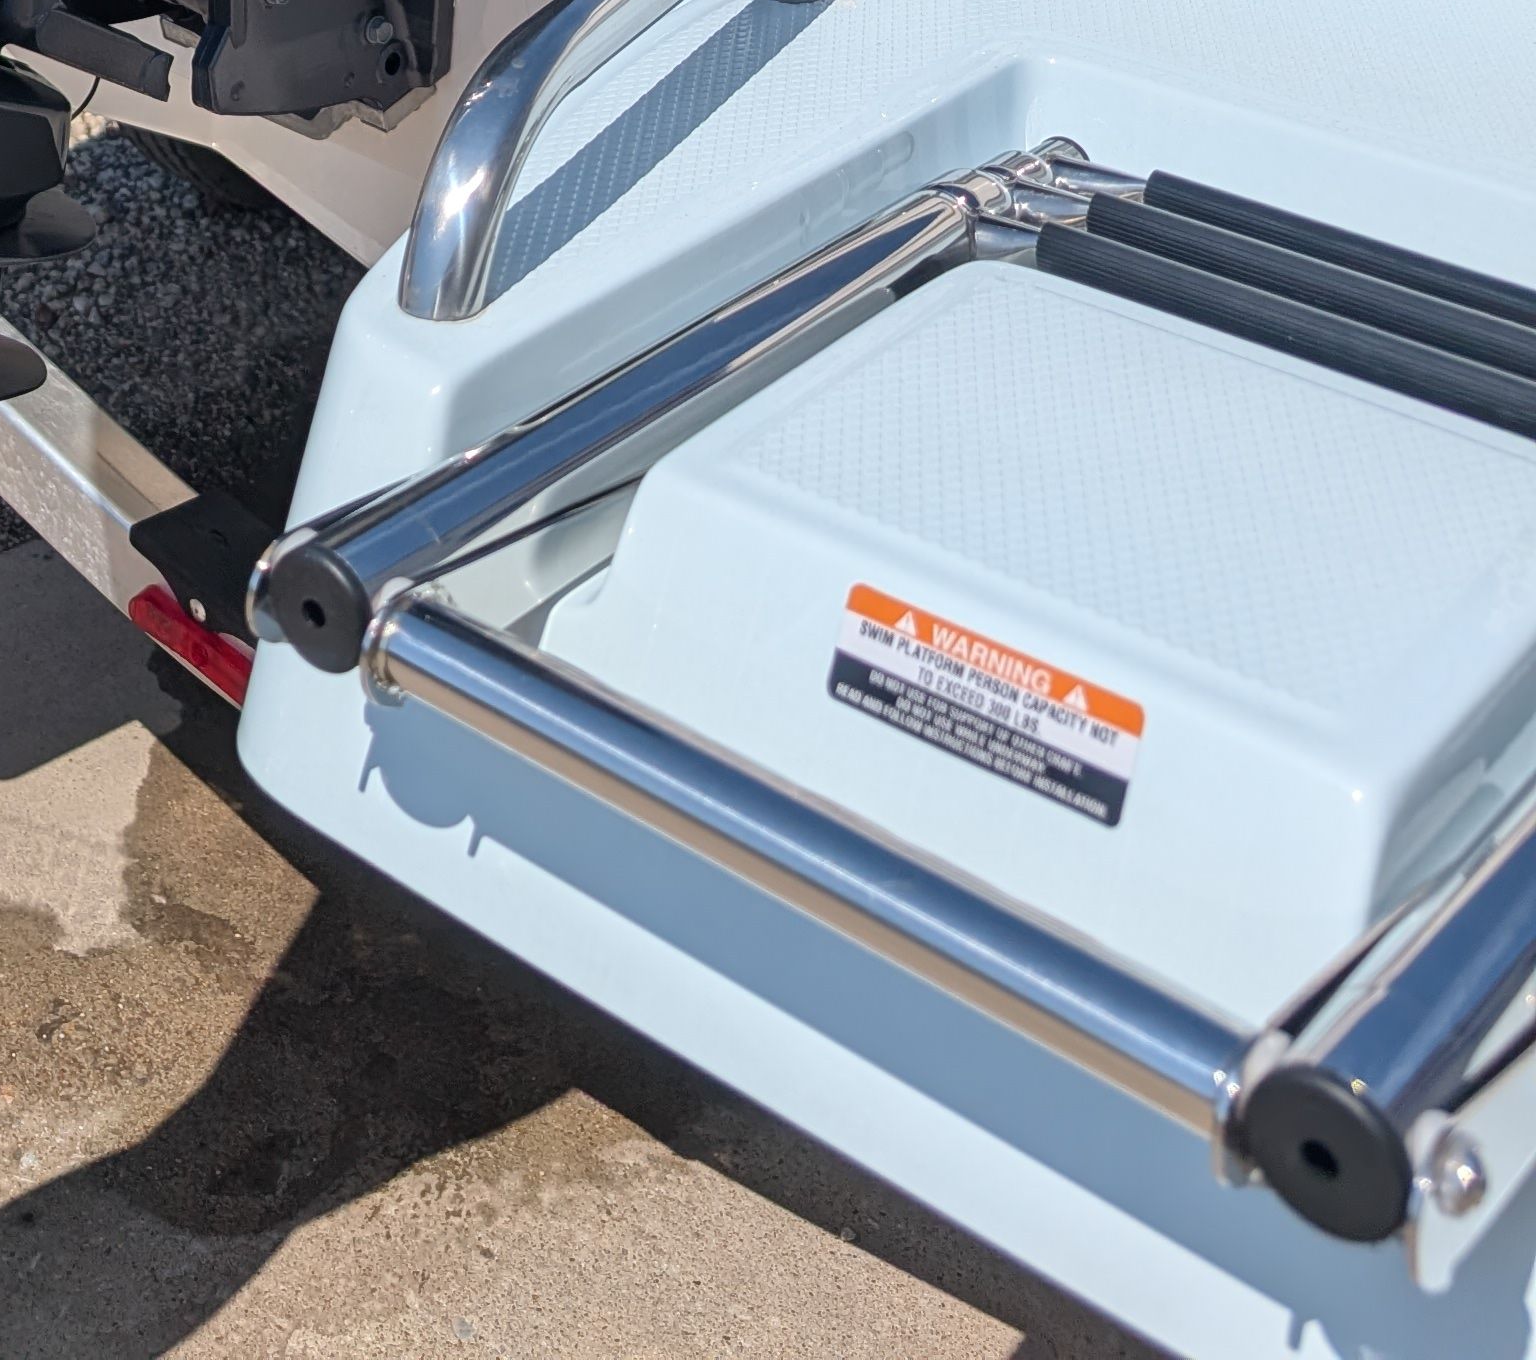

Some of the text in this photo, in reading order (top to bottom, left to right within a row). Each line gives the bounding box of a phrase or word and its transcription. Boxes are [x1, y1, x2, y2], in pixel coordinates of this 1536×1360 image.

[859, 620, 1118, 746] SWIM PLATFORM PERSON CAPACITY NOT
[916, 666, 933, 686] TO
[936, 675, 984, 708] EXCEED
[987, 698, 1011, 720] 300
[931, 625, 1052, 694] WARNING
